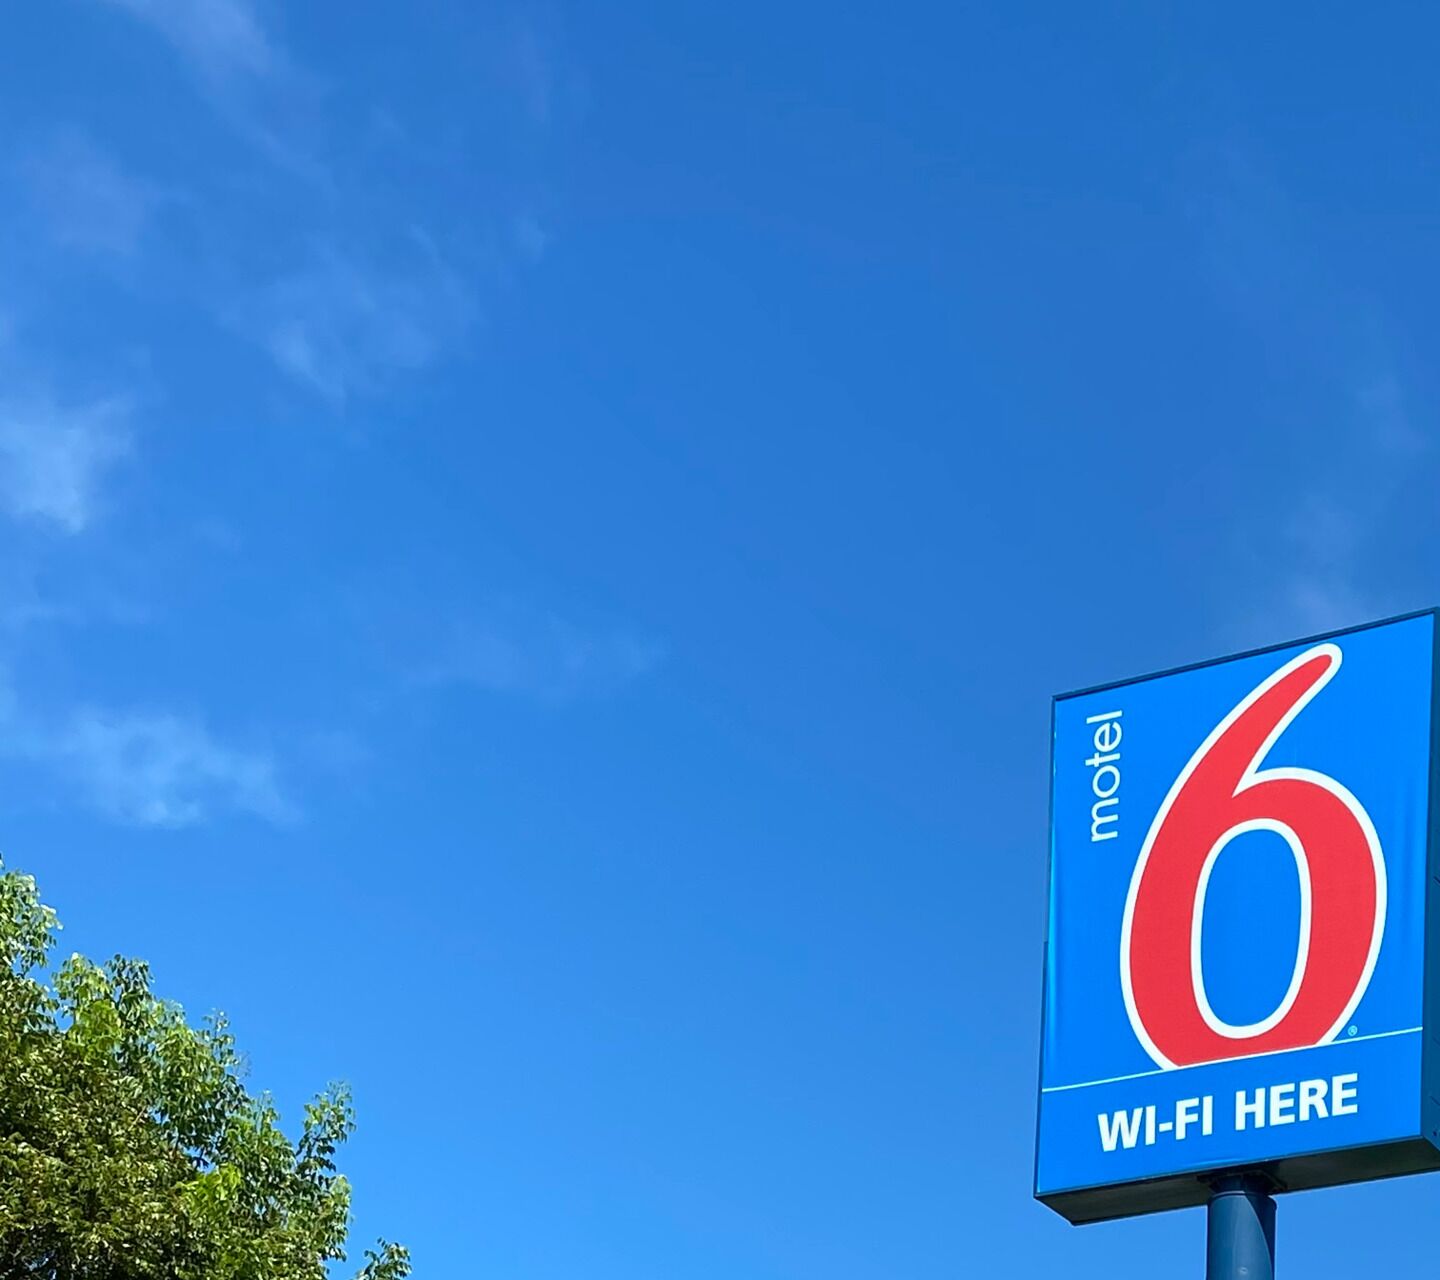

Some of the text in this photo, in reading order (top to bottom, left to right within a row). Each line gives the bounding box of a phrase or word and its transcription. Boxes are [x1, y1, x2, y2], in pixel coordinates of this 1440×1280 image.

[1085, 709, 1122, 842] motel
[1120, 643, 1387, 1070] 6
[1097, 1072, 1358, 1153] WI-FI HERE
